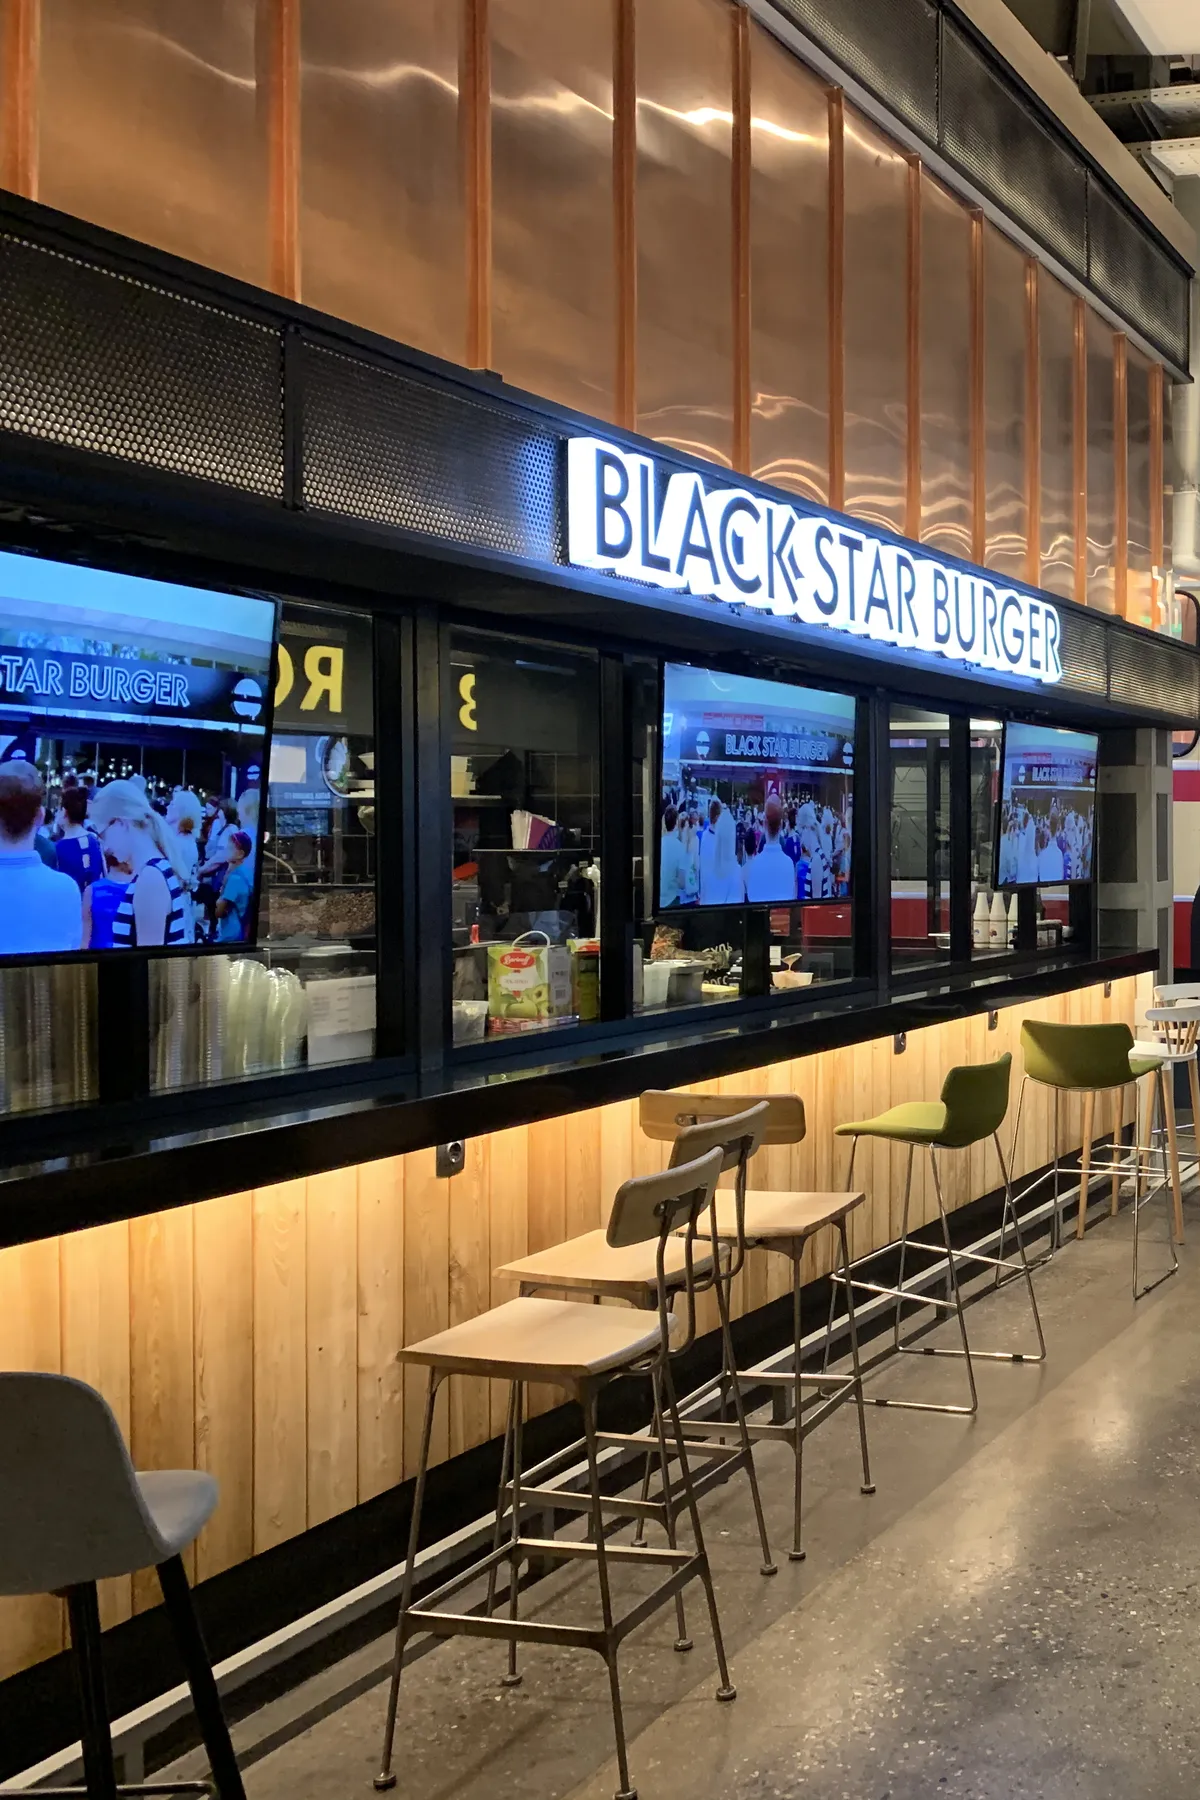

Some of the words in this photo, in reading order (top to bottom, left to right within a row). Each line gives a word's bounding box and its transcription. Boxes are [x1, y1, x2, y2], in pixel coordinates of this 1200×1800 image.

[594, 447, 801, 605] BLACK
[813, 523, 920, 639] STAR
[933, 570, 1062, 676] BURGER
[0, 655, 64, 696] TAR
[70, 662, 190, 708] BURGER
[725, 734, 762, 756] BLACK
[762, 736, 788, 759] STAR
[789, 738, 829, 762] BURGER
